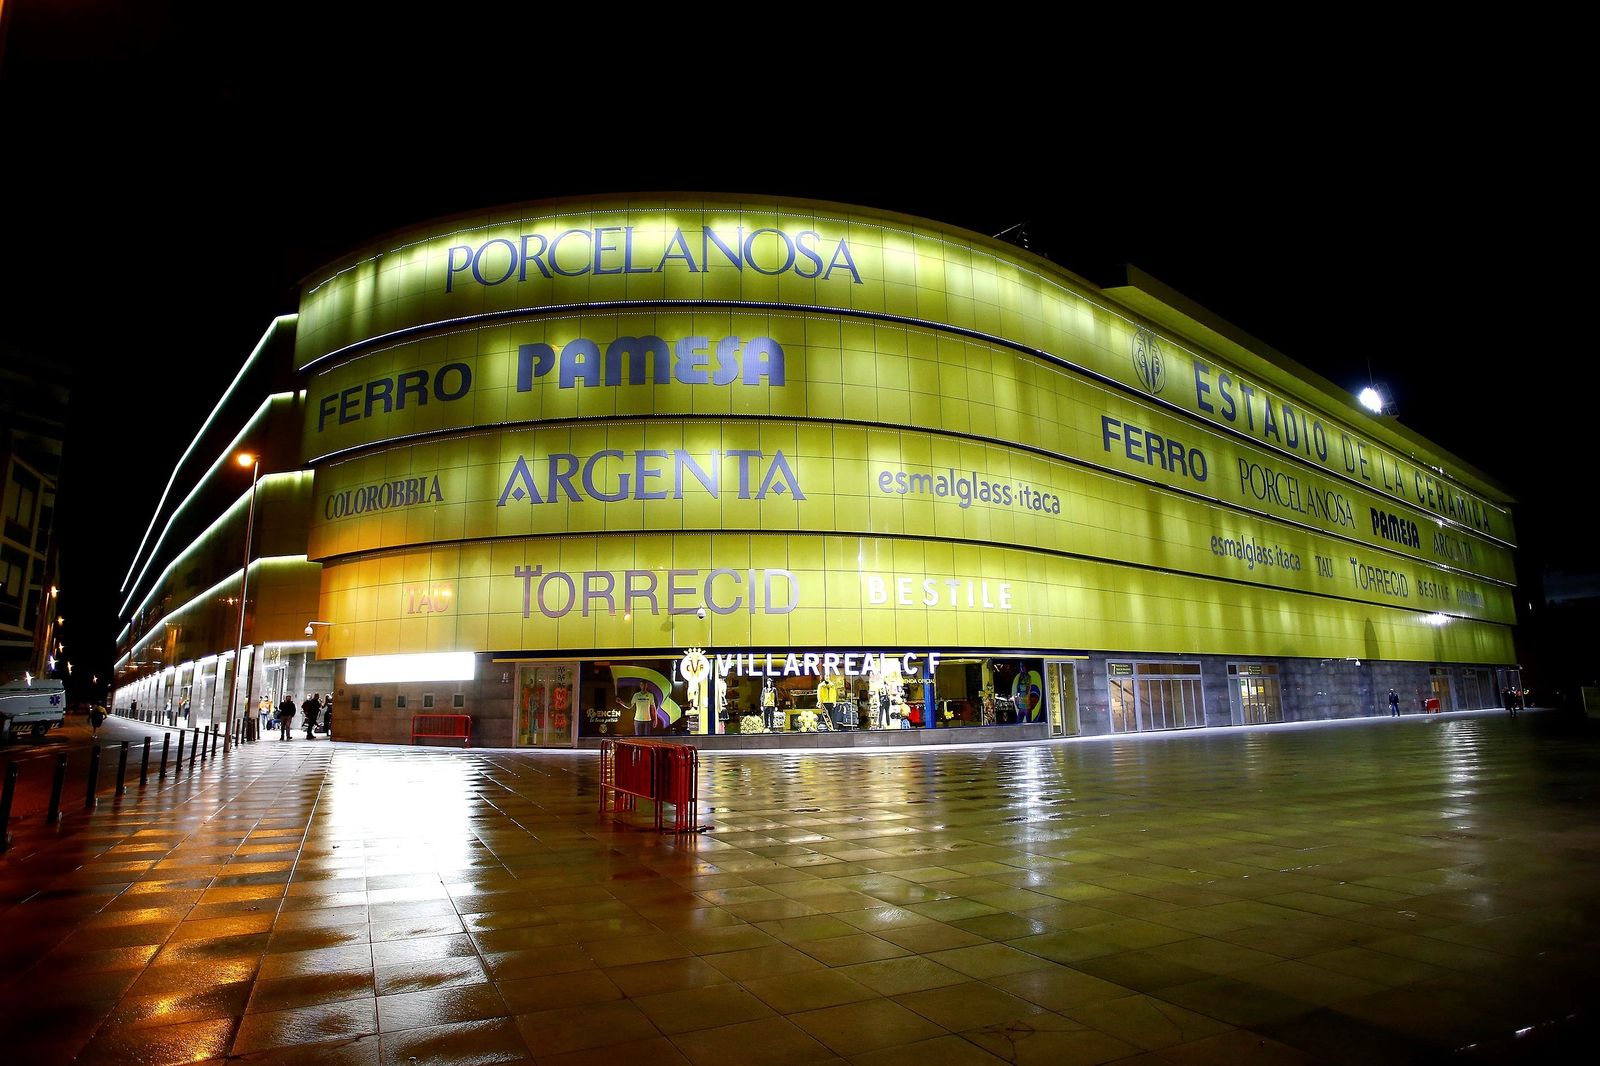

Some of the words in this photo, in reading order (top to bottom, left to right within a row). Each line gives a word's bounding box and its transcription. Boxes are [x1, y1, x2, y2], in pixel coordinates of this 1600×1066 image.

[444, 226, 863, 293] PORCELANOSA
[517, 336, 785, 392] PAMESA
[317, 362, 473, 432] FERRO
[1101, 415, 1208, 482] FERRO
[1193, 360, 1329, 462] ESTADIO
[1341, 434, 1371, 481] DE
[1380, 452, 1405, 496] LA
[324, 475, 443, 521] COLOROBBIA
[496, 450, 806, 507] ARGENTA
[1238, 457, 1357, 530] PORCELANOSA
[1369, 506, 1421, 550] PAMESA
[514, 564, 800, 619] TORRECID
[1314, 555, 1334, 579] TAU
[1349, 557, 1410, 599] TORRECID
[1417, 579, 1450, 602] BESTILE
[404, 582, 451, 614] TAU
[867, 575, 1013, 610] BESTILE
[716, 653, 897, 677] VILLARREAL
[903, 652, 918, 675] C
[929, 652, 941, 674] F
